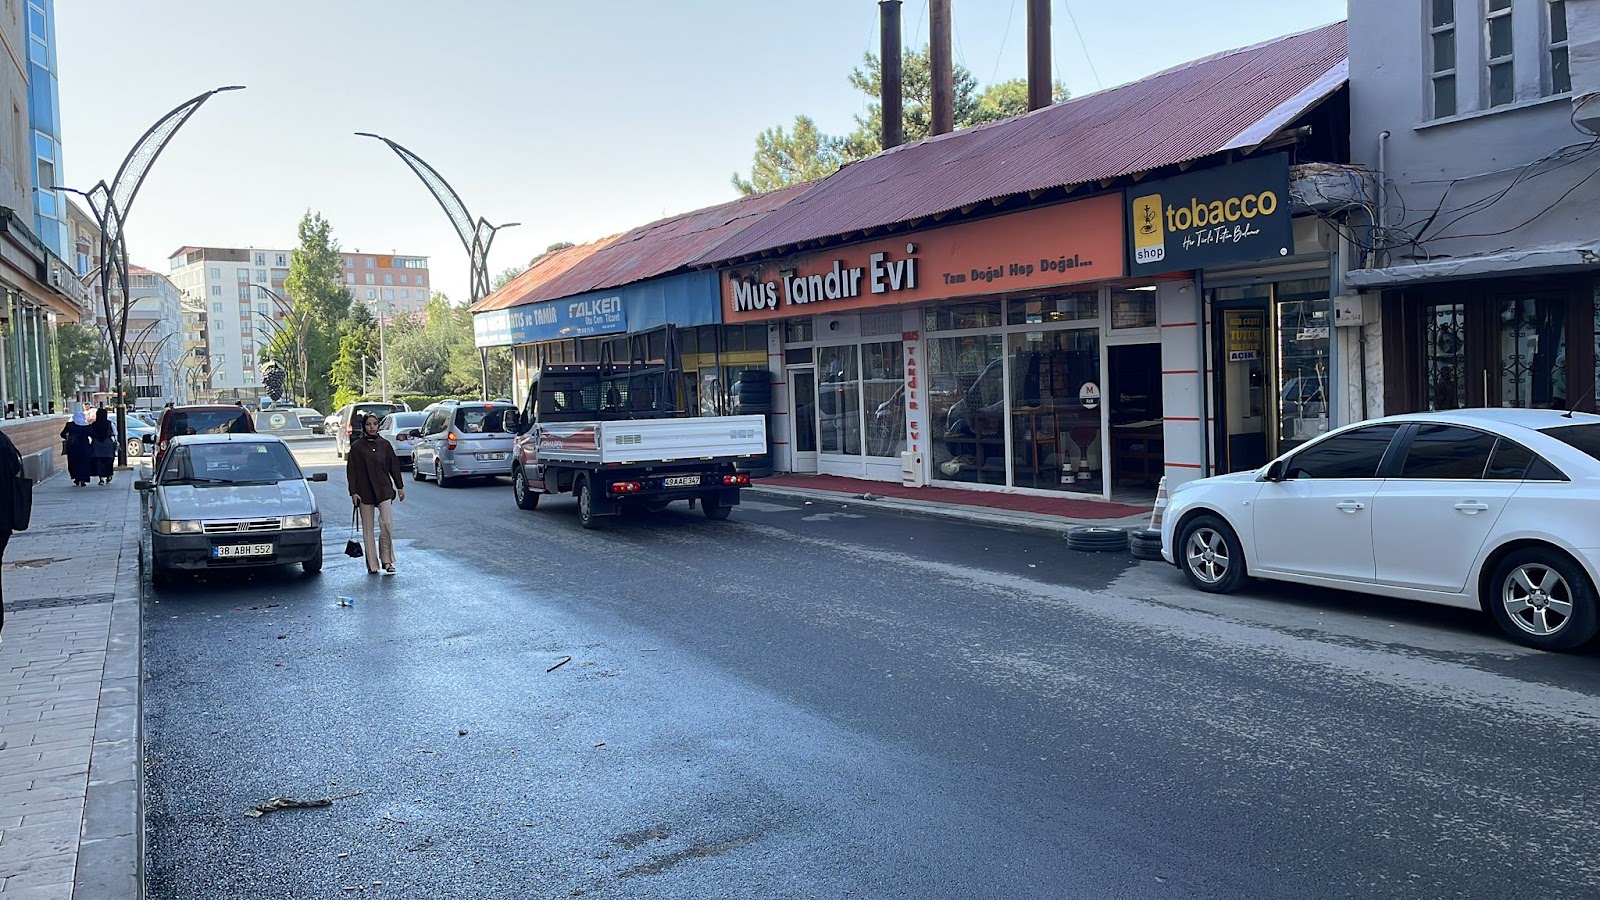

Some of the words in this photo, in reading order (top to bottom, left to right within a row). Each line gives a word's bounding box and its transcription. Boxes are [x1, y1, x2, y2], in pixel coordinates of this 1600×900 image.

[1166, 191, 1277, 232] tobacco
[1138, 247, 1163, 260] shop
[733, 279, 778, 312] Muş
[781, 259, 864, 305] Tandır
[870, 242, 918, 294] Evi
[943, 271, 966, 285] Tam
[971, 264, 1004, 282] Doğal
[1009, 261, 1034, 278] Hep
[1040, 254, 1093, 273] Doğal...
[569, 296, 621, 319] FALKEN
[1232, 352, 1254, 360] AÇIK
[219, 547, 230, 556] 38
[234, 546, 251, 555] ABH
[254, 545, 271, 554] 552
